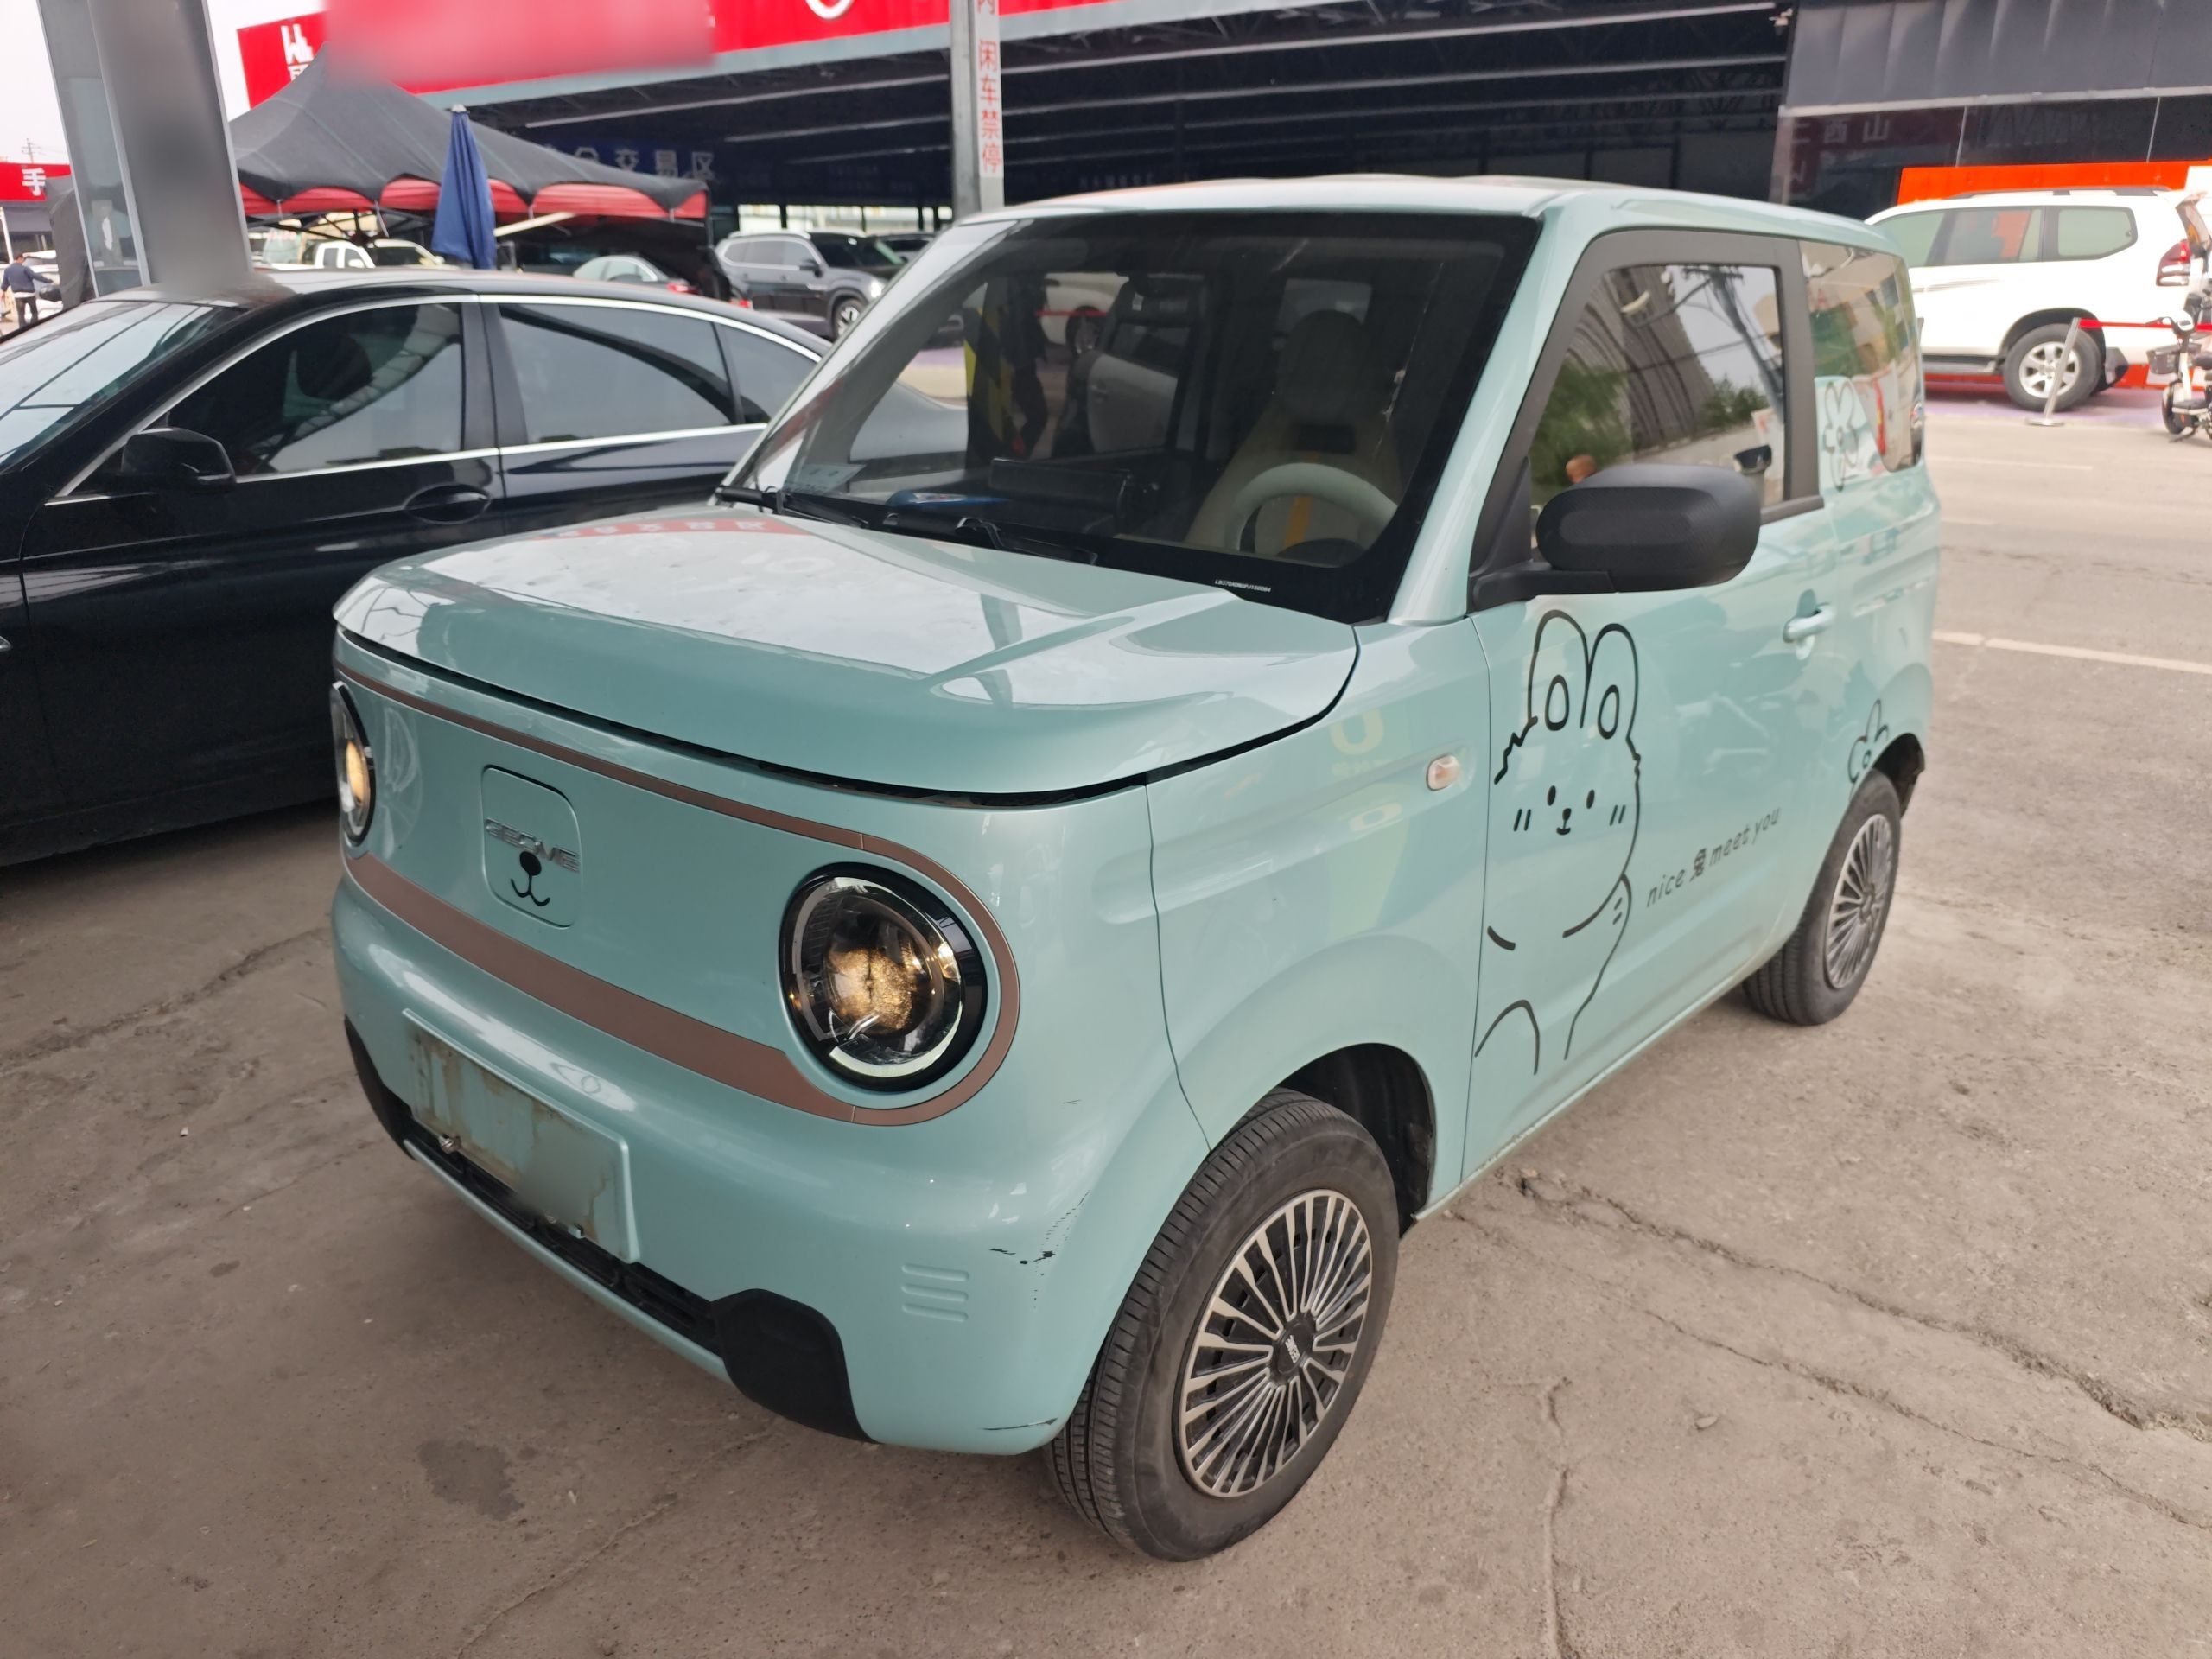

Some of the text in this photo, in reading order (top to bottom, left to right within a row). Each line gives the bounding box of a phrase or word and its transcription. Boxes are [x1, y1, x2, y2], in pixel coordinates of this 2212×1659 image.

[978, 39, 1001, 173] 闲车禁停
[22, 167, 47, 197] 手
[485, 817, 581, 874] GEOME
[1646, 868, 1686, 908] nice
[1709, 823, 1750, 867] meet
[1751, 806, 1782, 845] you
